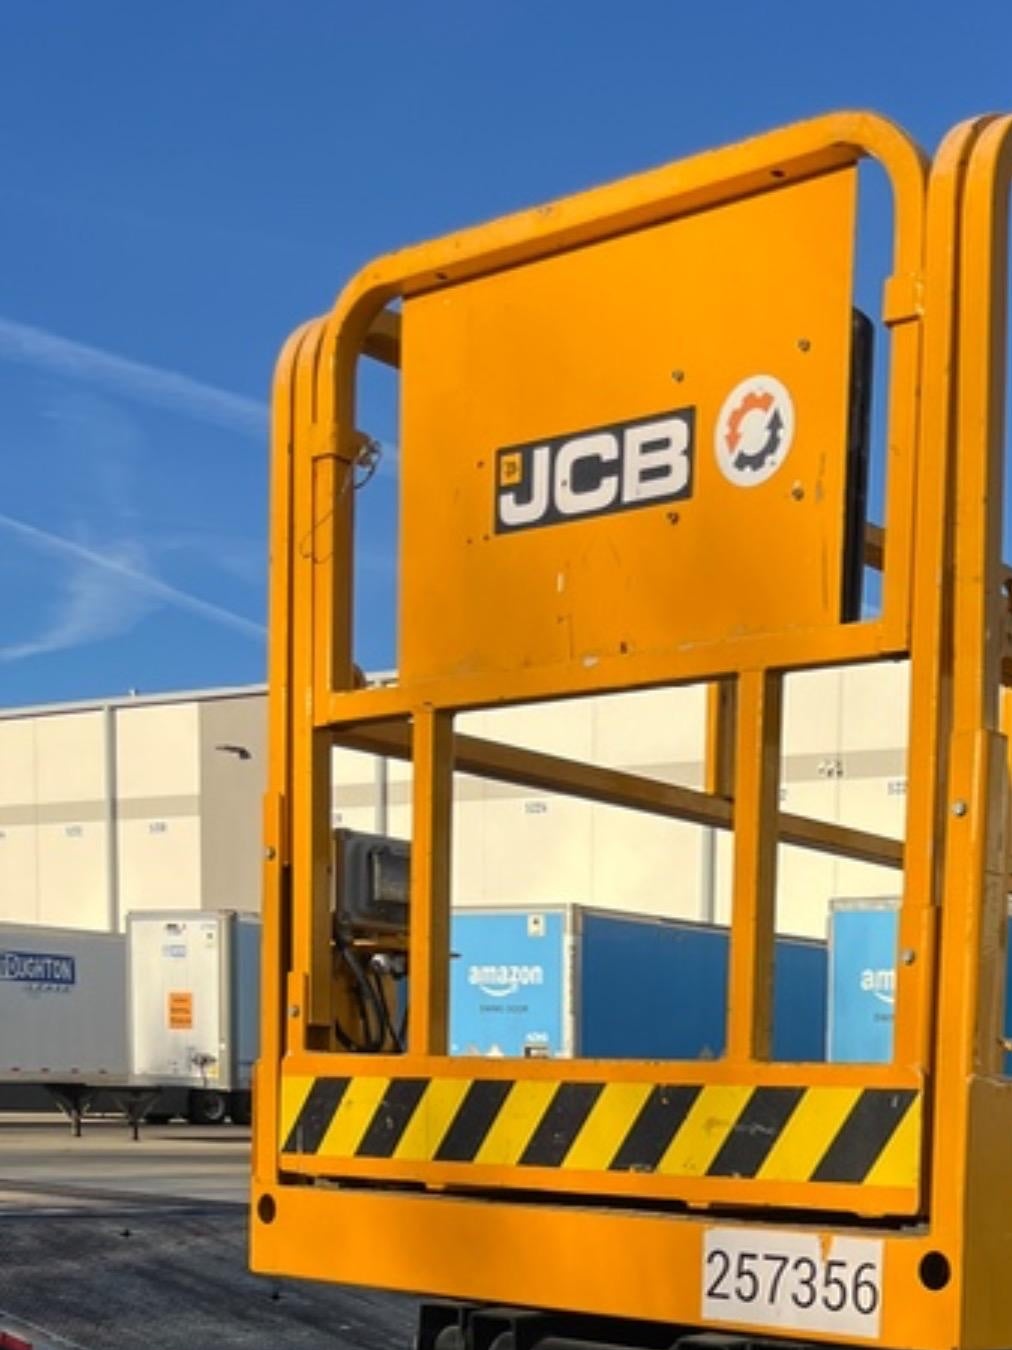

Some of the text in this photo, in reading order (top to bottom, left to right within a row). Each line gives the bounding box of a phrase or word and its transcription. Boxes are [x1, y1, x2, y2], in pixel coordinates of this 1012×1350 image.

[500, 416, 690, 527] JCB
[468, 965, 543, 987] amazon
[706, 1249, 879, 1315] 257356
